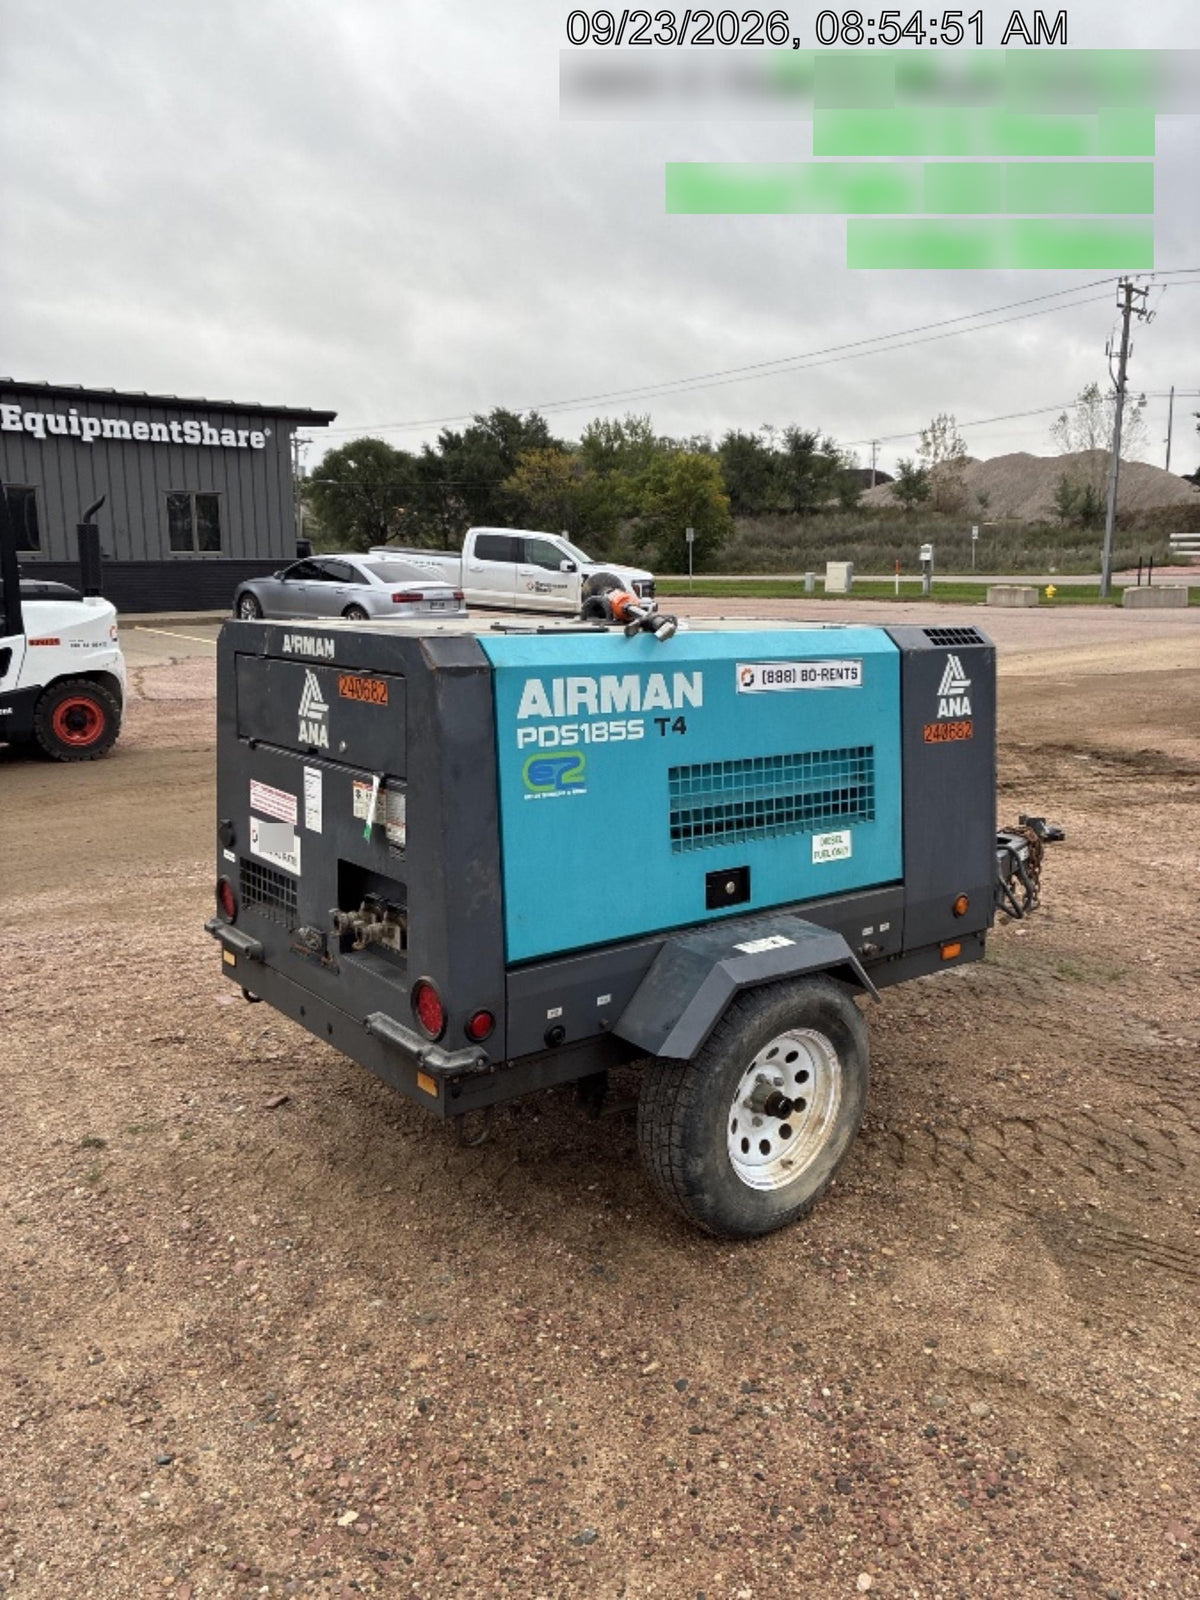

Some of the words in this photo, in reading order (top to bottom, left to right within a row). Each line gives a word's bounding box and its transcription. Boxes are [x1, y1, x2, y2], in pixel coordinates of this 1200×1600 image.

[282, 634, 335, 659] AIRMAN
[340, 674, 387, 704] 240682
[517, 671, 703, 719] AIRMAN
[937, 696, 972, 719] ANA
[298, 720, 329, 749] ANA
[517, 719, 644, 749] PDS185S
[654, 716, 687, 736] T4
[925, 721, 972, 742] 240682
